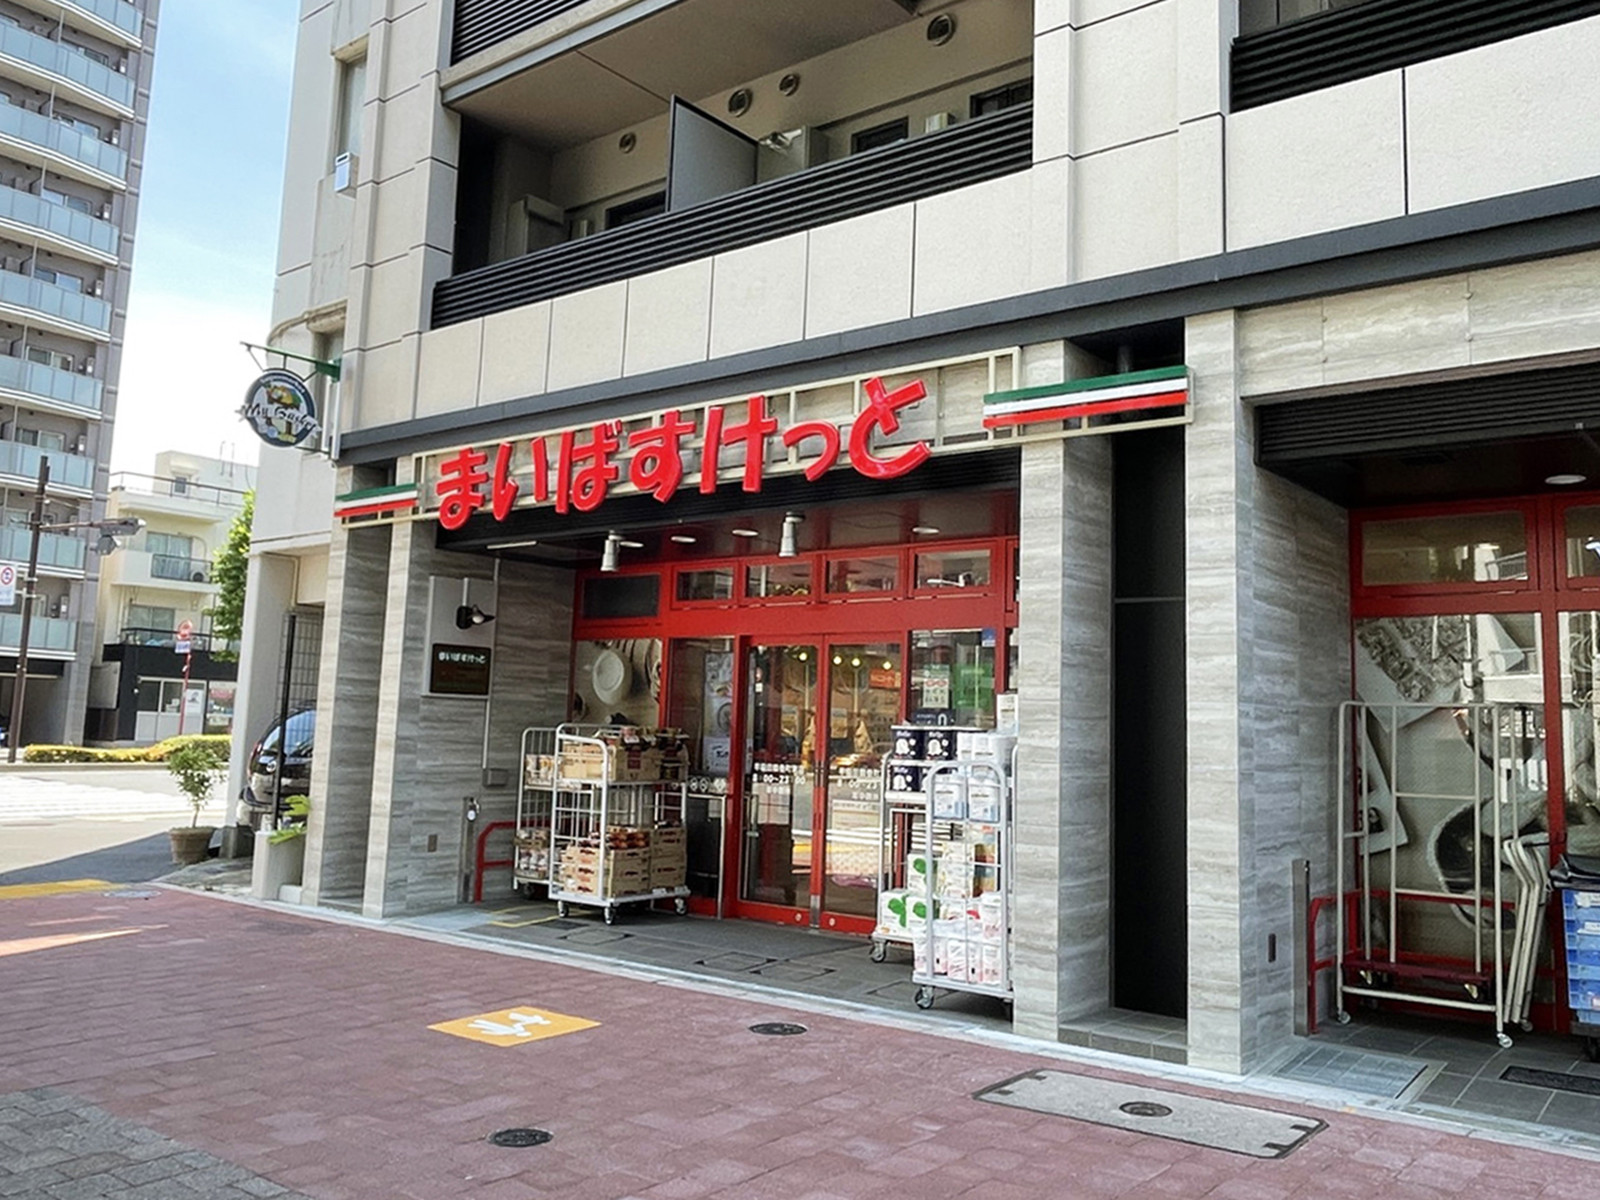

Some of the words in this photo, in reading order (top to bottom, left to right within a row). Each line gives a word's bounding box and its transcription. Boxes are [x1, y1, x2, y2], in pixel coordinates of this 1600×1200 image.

[435, 376, 932, 531] まいばすけっと
